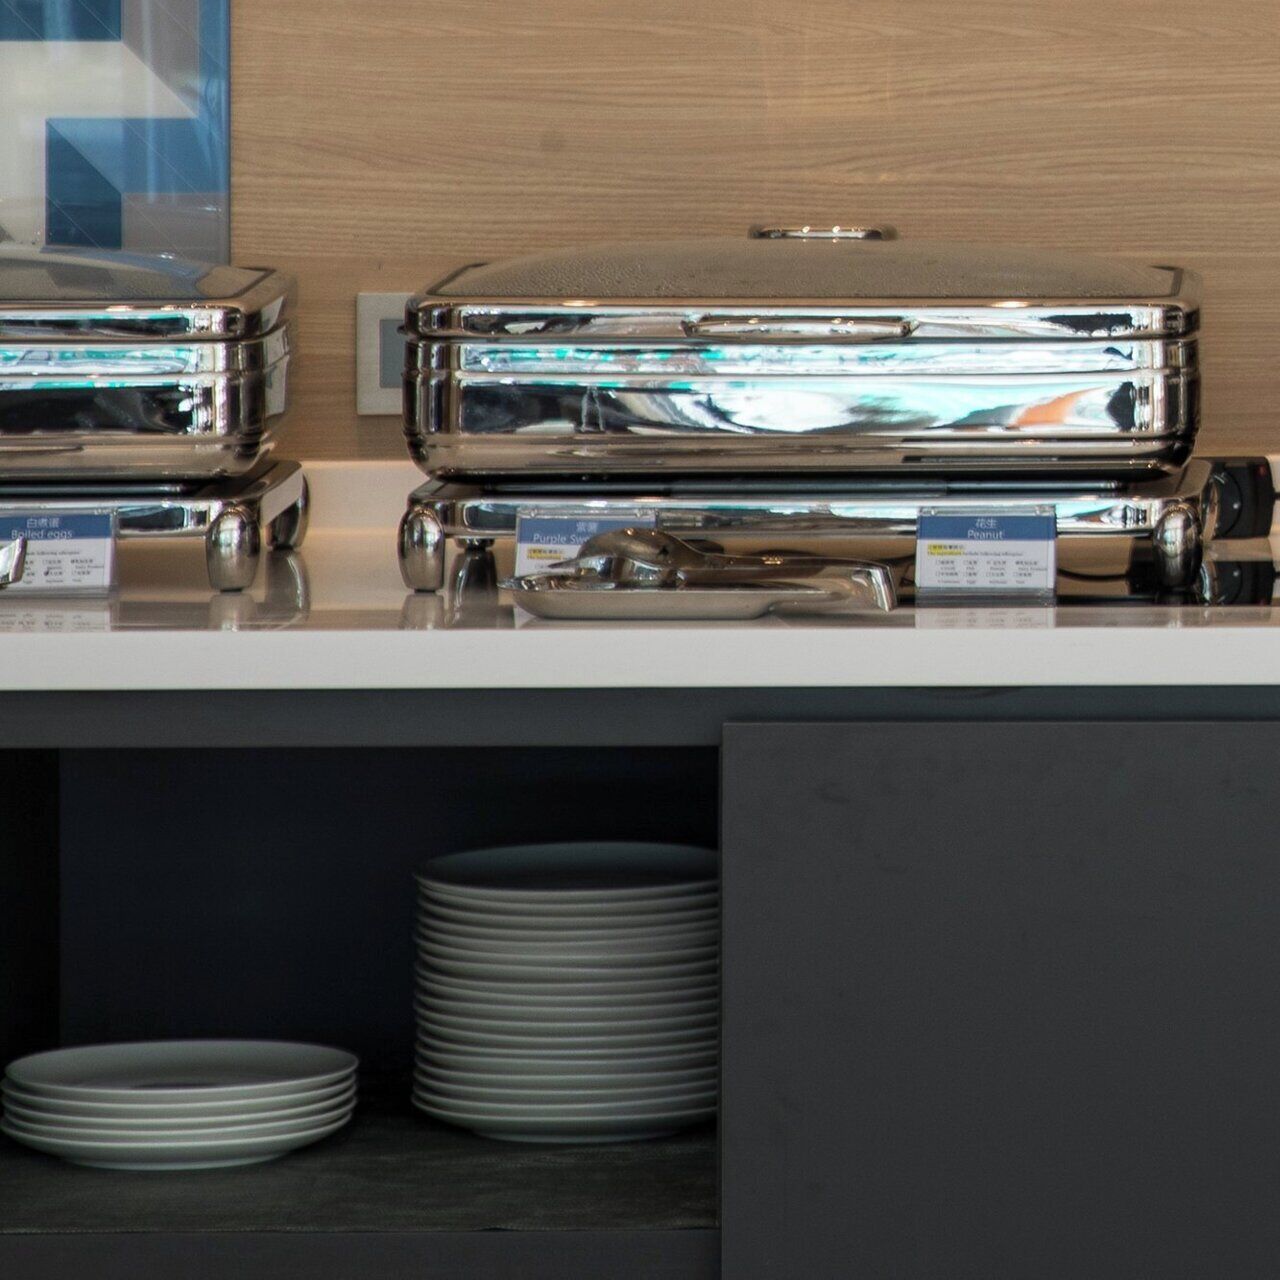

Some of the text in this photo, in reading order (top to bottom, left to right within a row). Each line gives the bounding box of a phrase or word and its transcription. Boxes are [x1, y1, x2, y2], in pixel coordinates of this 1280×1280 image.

[976, 518, 998, 529] 花生
[11, 529, 73, 540] Boiled eggs
[533, 533, 567, 545] Purple
[968, 530, 1004, 540] Peanut
